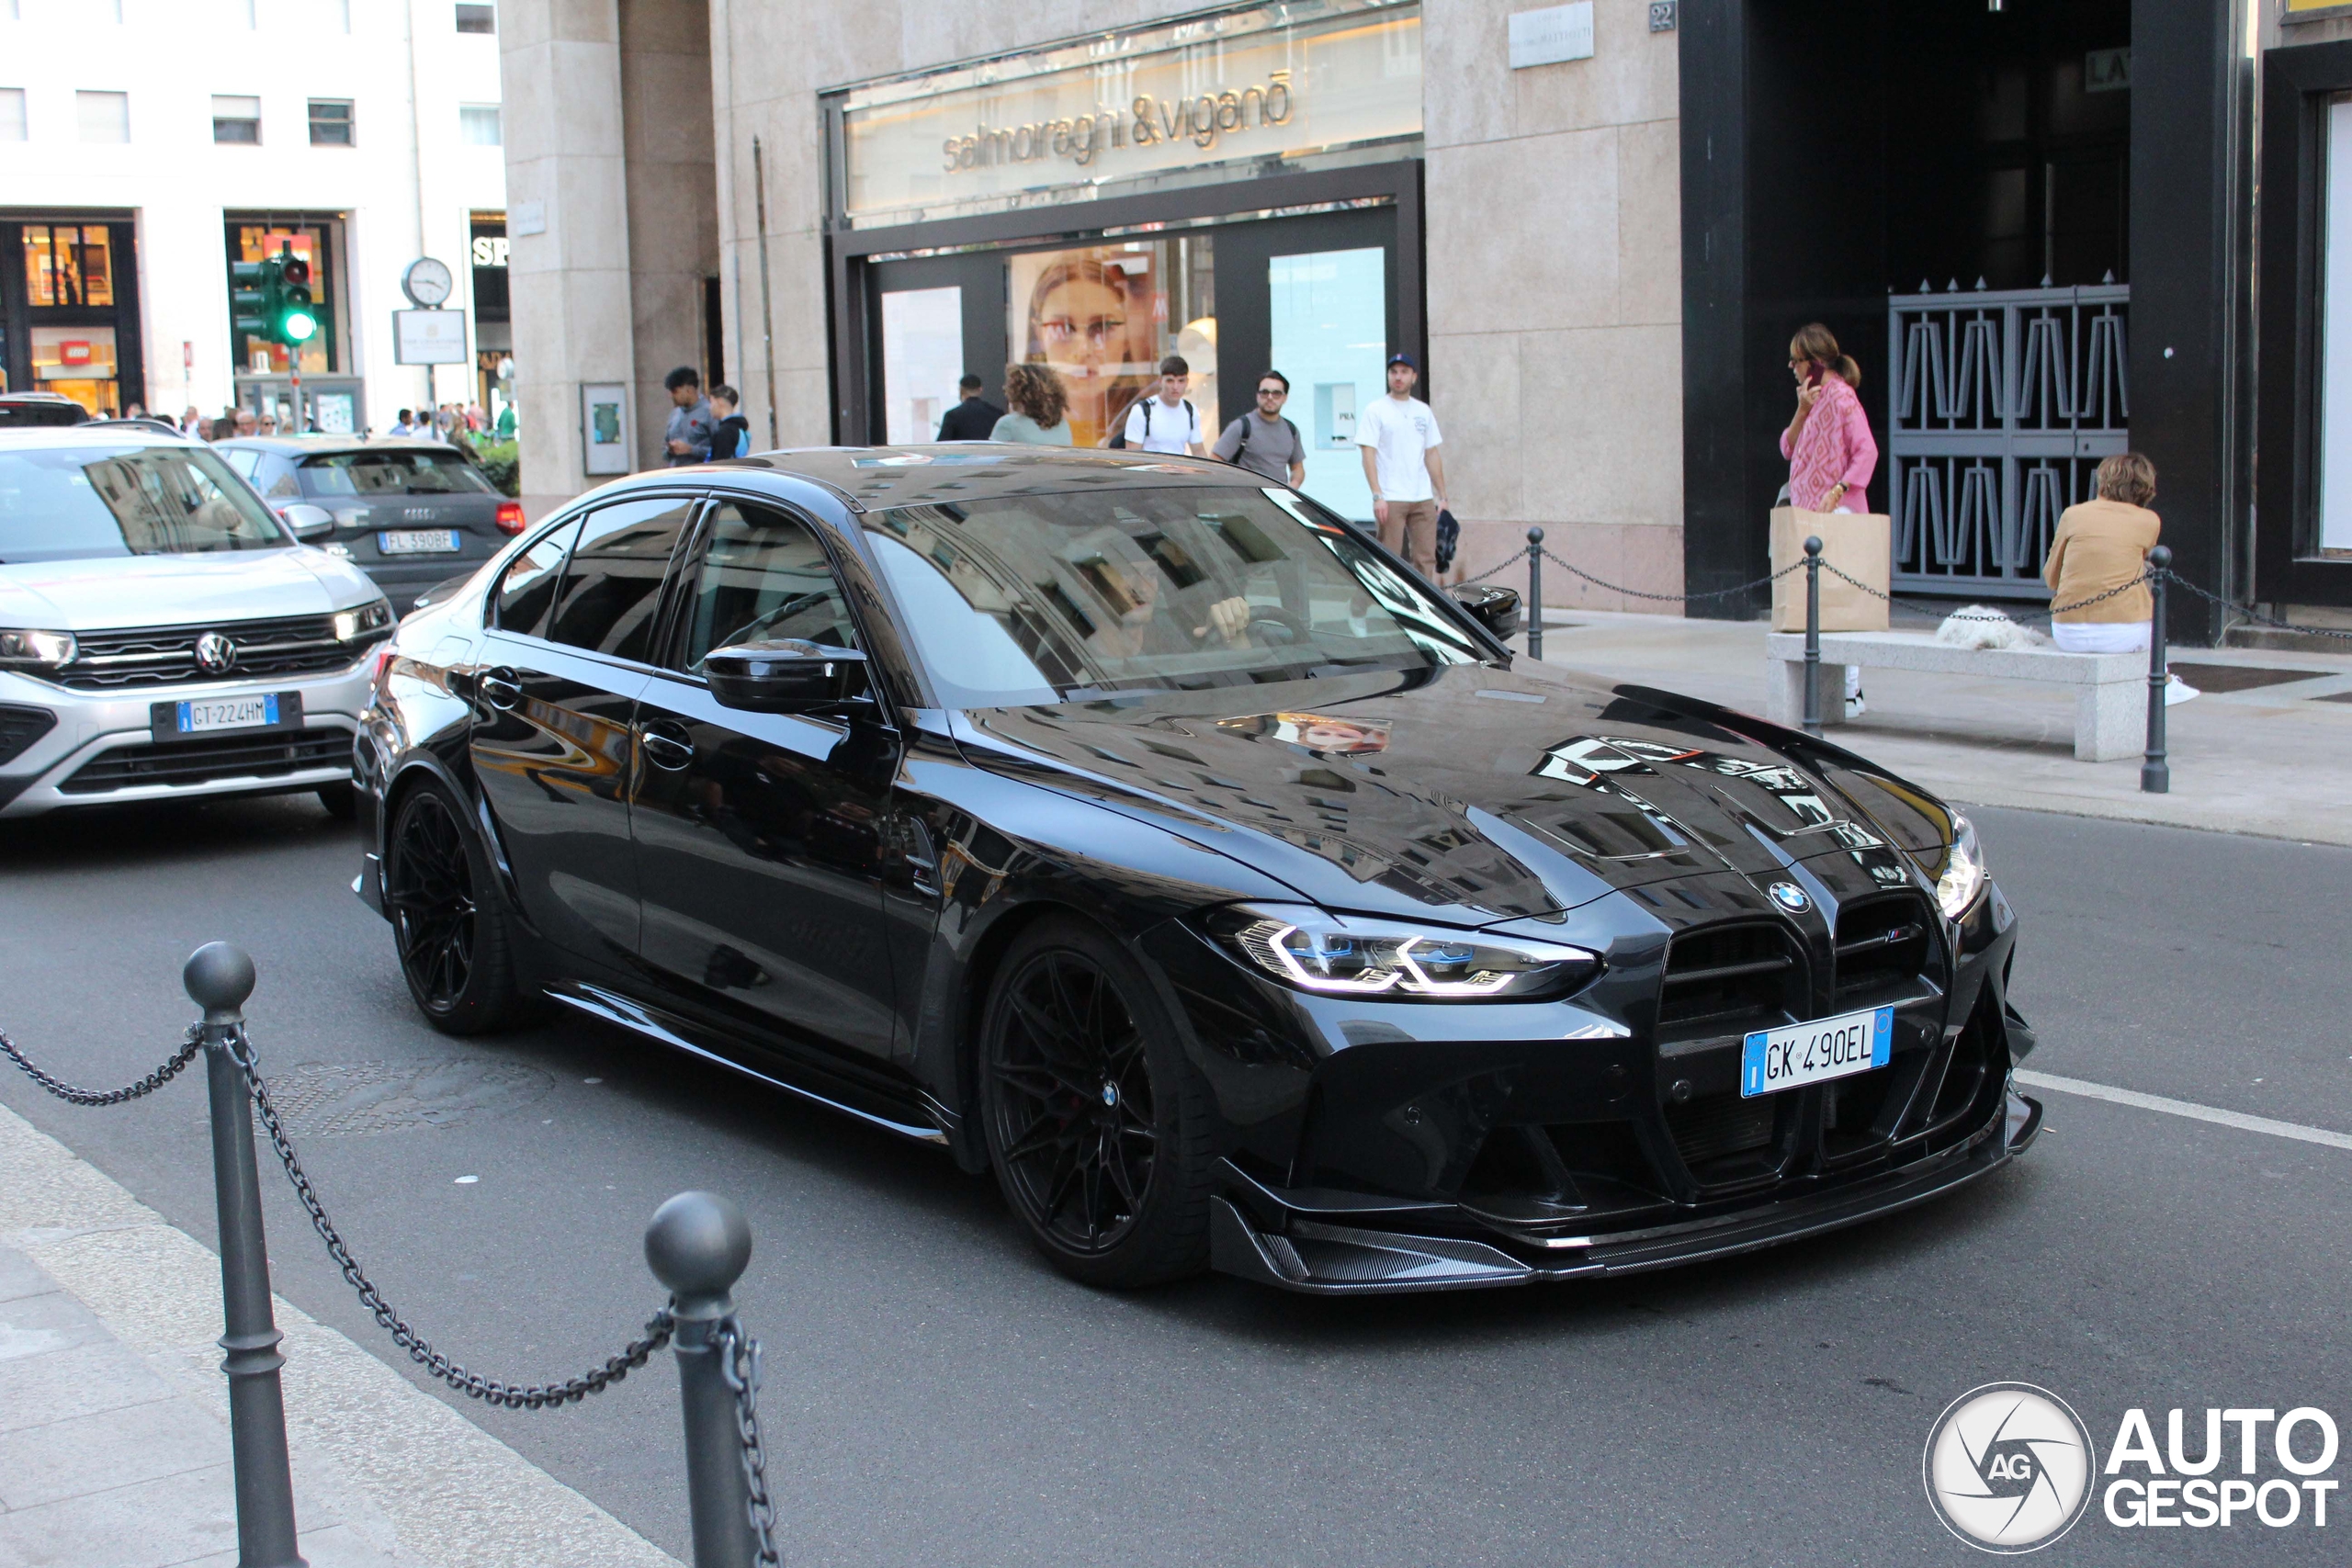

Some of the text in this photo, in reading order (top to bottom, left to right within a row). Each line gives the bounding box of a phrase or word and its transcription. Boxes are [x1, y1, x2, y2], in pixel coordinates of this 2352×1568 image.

[1651, 4, 1671, 27] 22
[2089, 51, 2132, 84] LA
[943, 102, 1127, 174] salmoiraghi
[194, 706, 212, 726] GT
[218, 702, 266, 724] 224HM
[1767, 1039, 1796, 1079] GK
[1803, 1024, 1871, 1071] 490EL
